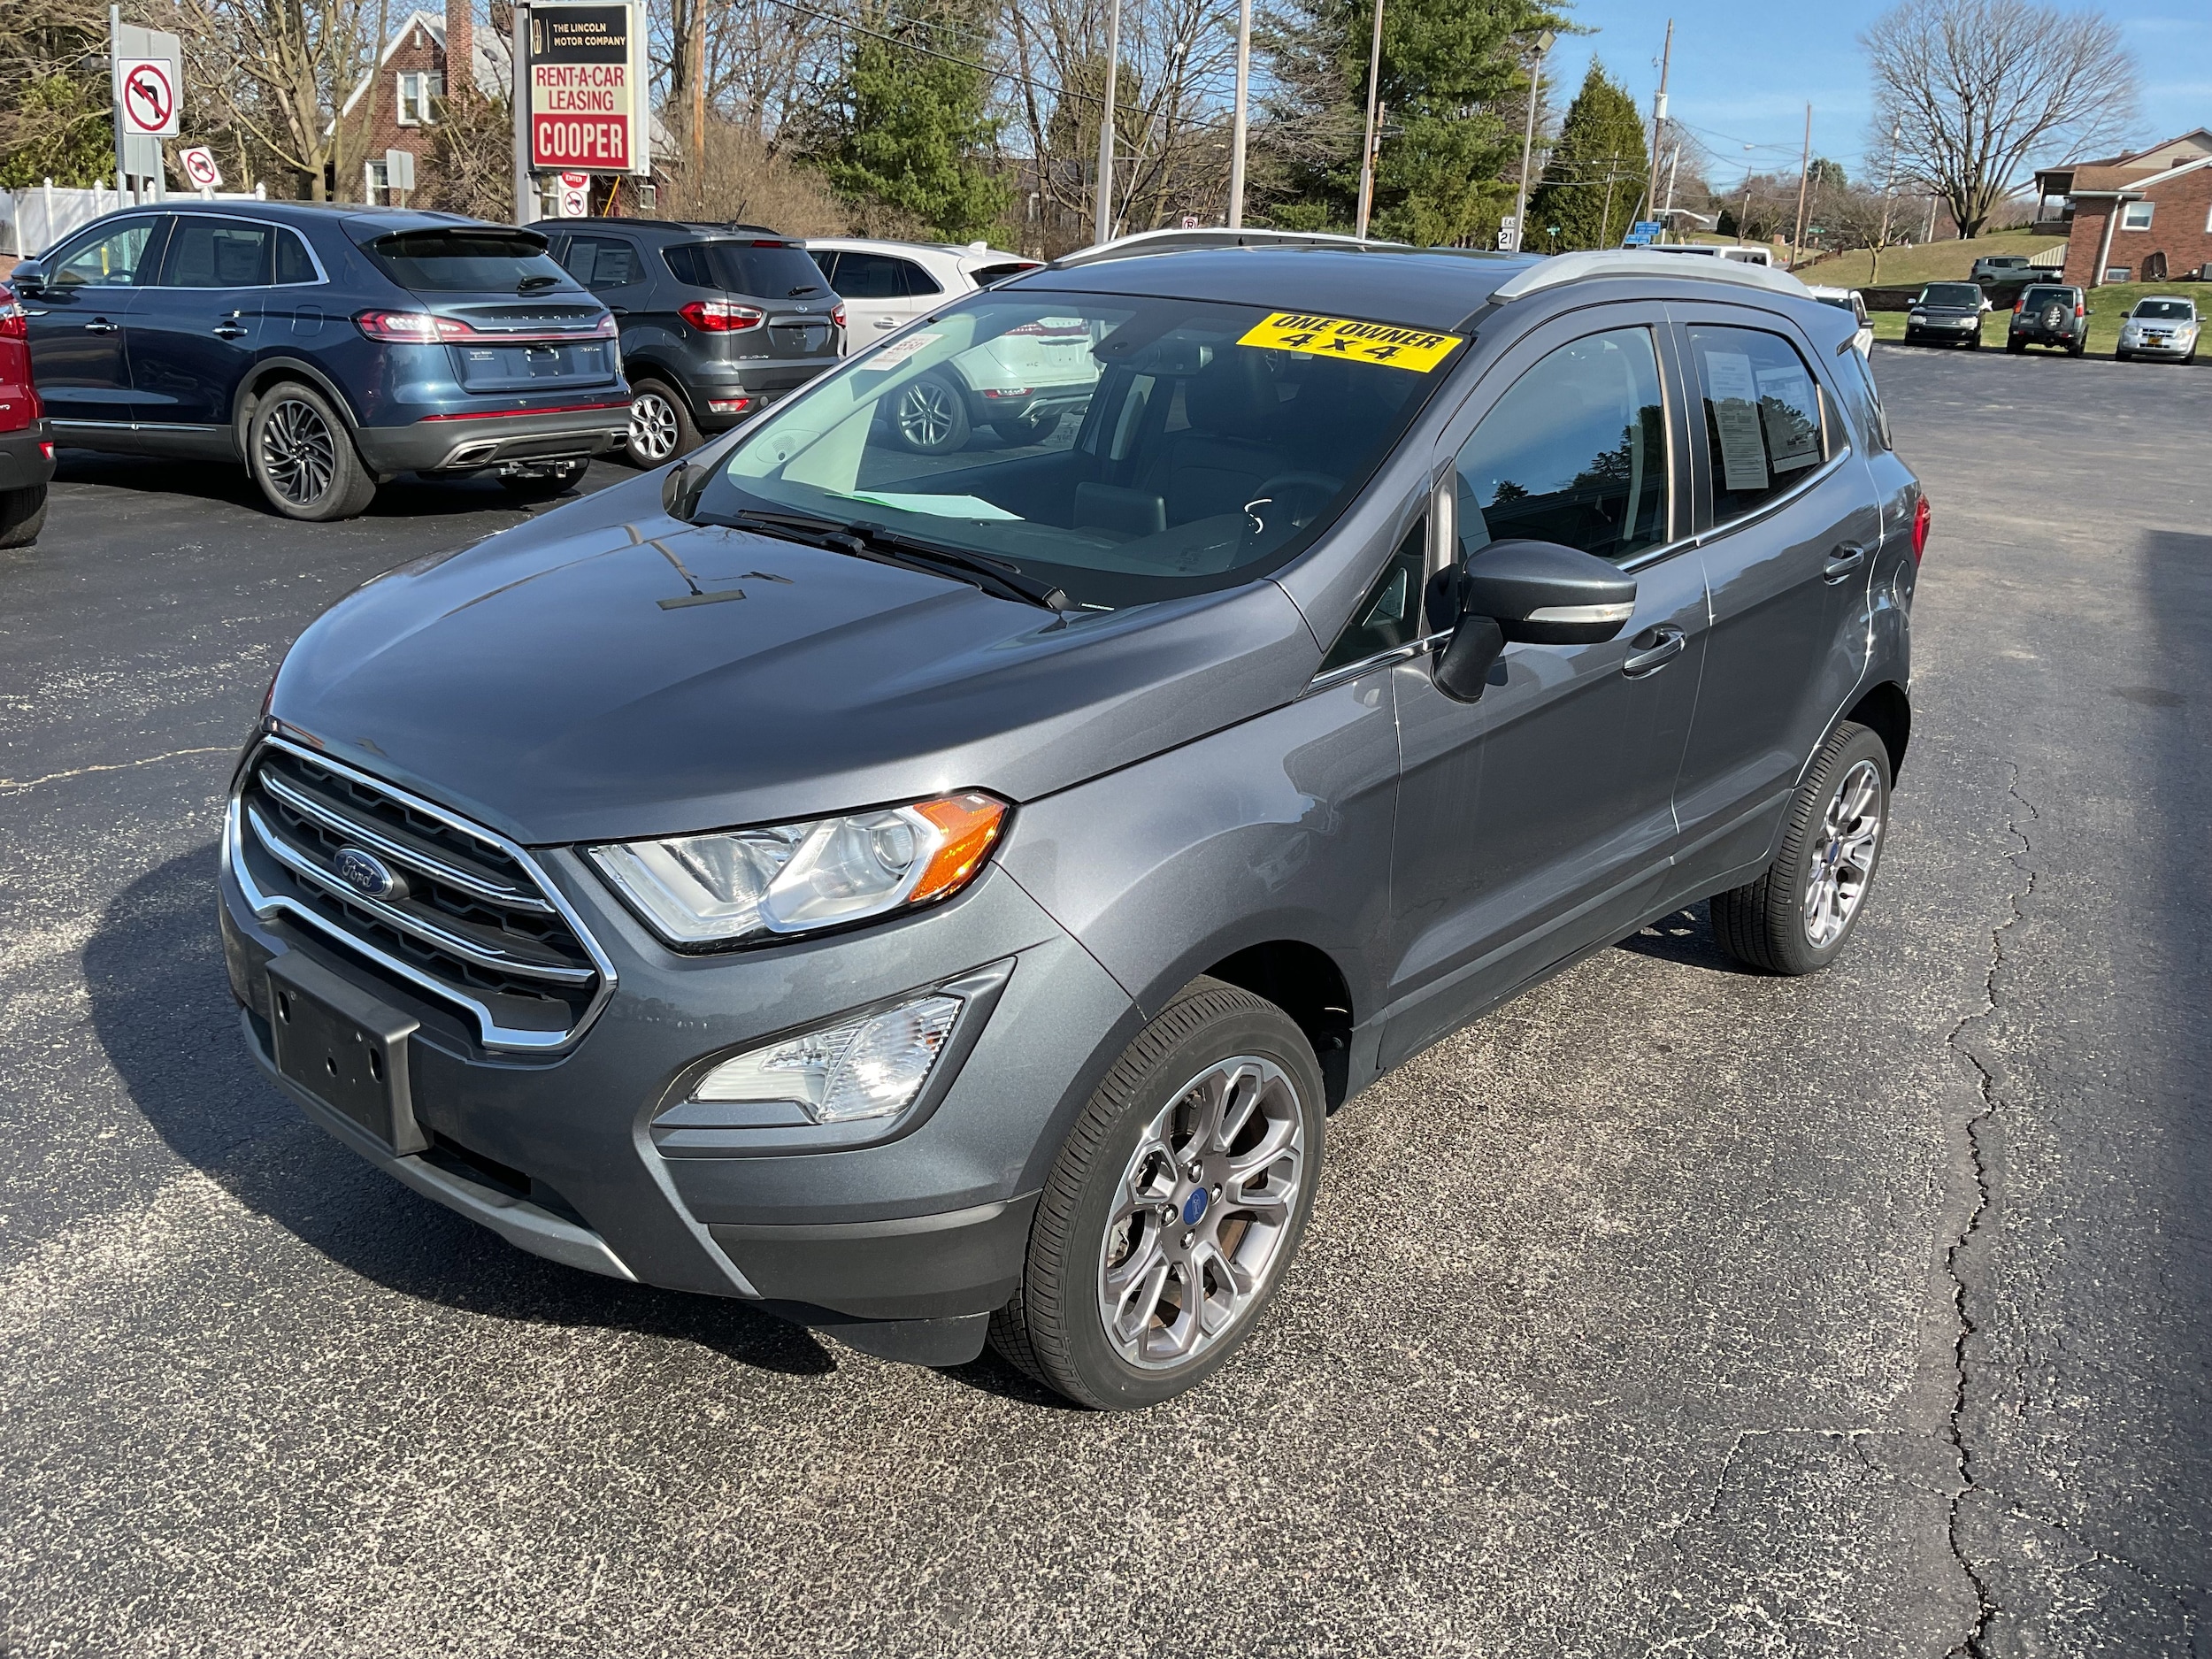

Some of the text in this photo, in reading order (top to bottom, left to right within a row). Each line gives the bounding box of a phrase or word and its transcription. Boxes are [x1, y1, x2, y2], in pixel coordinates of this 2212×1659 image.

[553, 23, 606, 33] THE LINCOLN
[554, 36, 626, 46] MOTOR COMPANY
[536, 66, 624, 87] RENT-A-CAR
[549, 90, 614, 111] LEASING
[539, 122, 623, 158] COOPER
[565, 174, 583, 183] ENTER
[1504, 218, 1516, 227] EAS
[1500, 232, 1512, 244] 21
[1271, 315, 1446, 349] ONE OWNER
[1279, 333, 1317, 348] 4
[1363, 345, 1402, 360] 4
[342, 856, 373, 887] Ford
